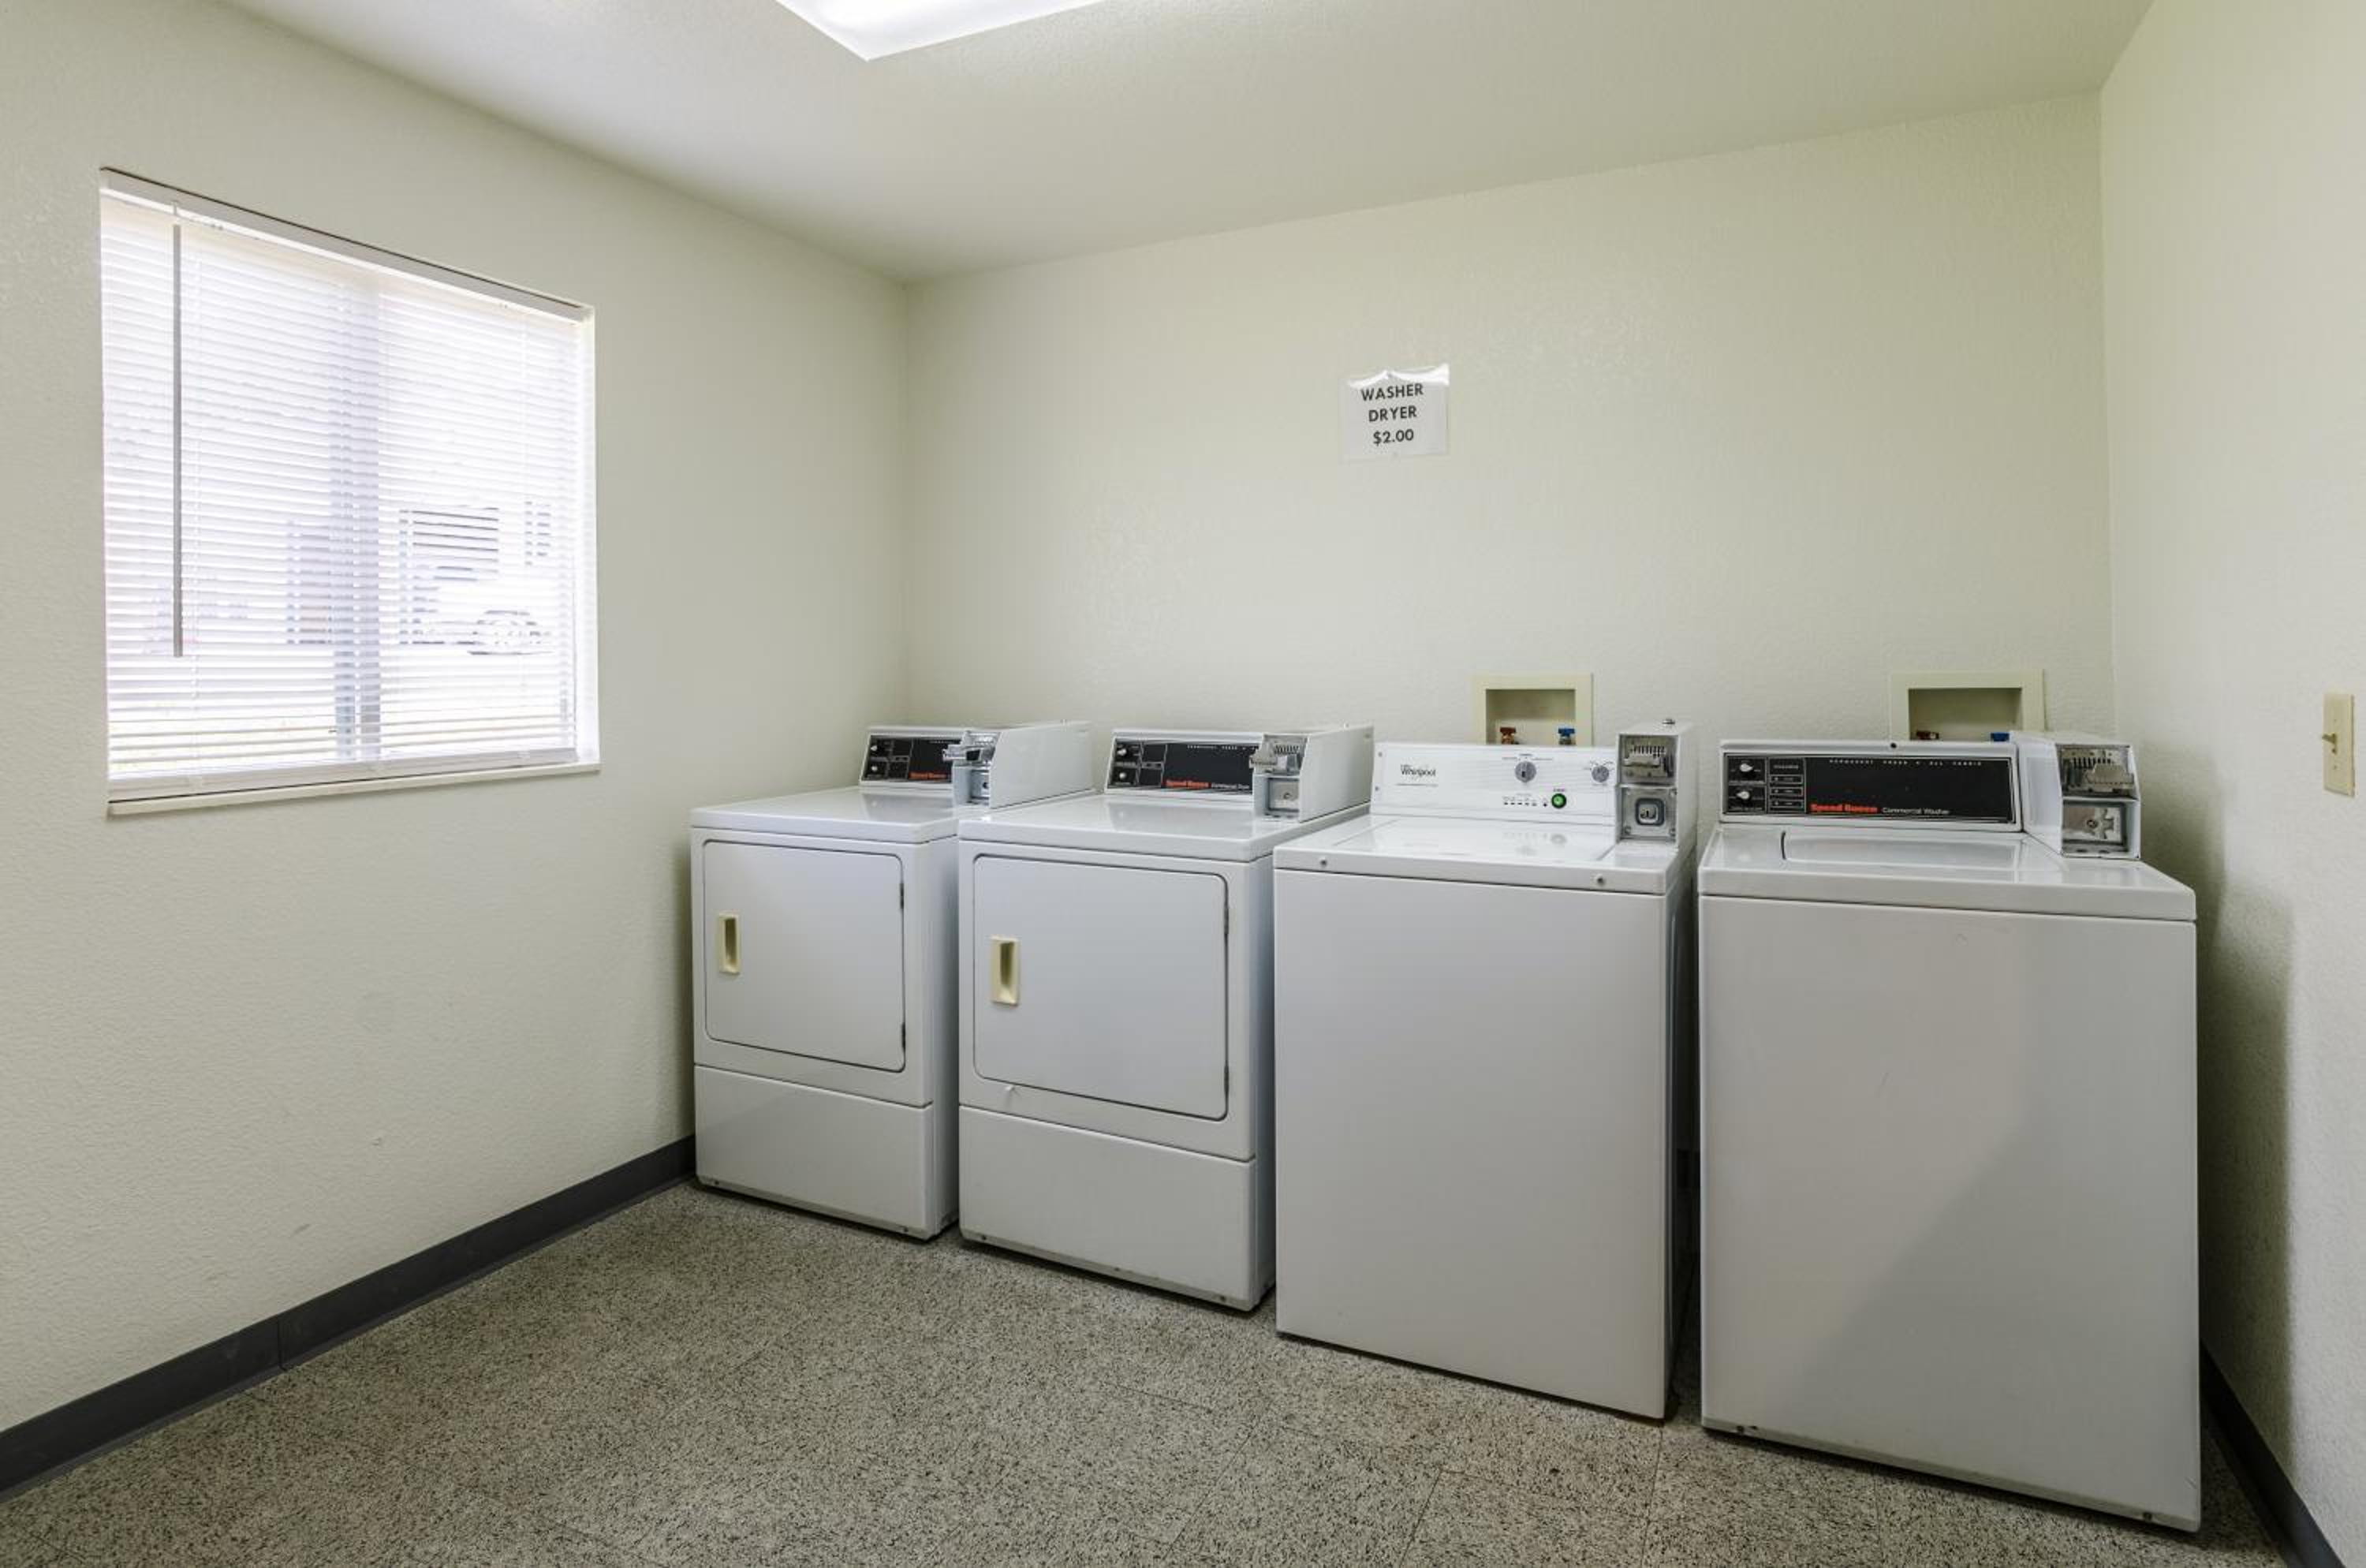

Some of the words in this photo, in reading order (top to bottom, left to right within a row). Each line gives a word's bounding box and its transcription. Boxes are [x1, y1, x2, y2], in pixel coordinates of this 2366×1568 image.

[1360, 383, 1424, 401] WASHER
[1368, 405, 1418, 422] DRYER
[1373, 428, 1414, 446] $2.00
[1400, 765, 1436, 778] Whirlpool
